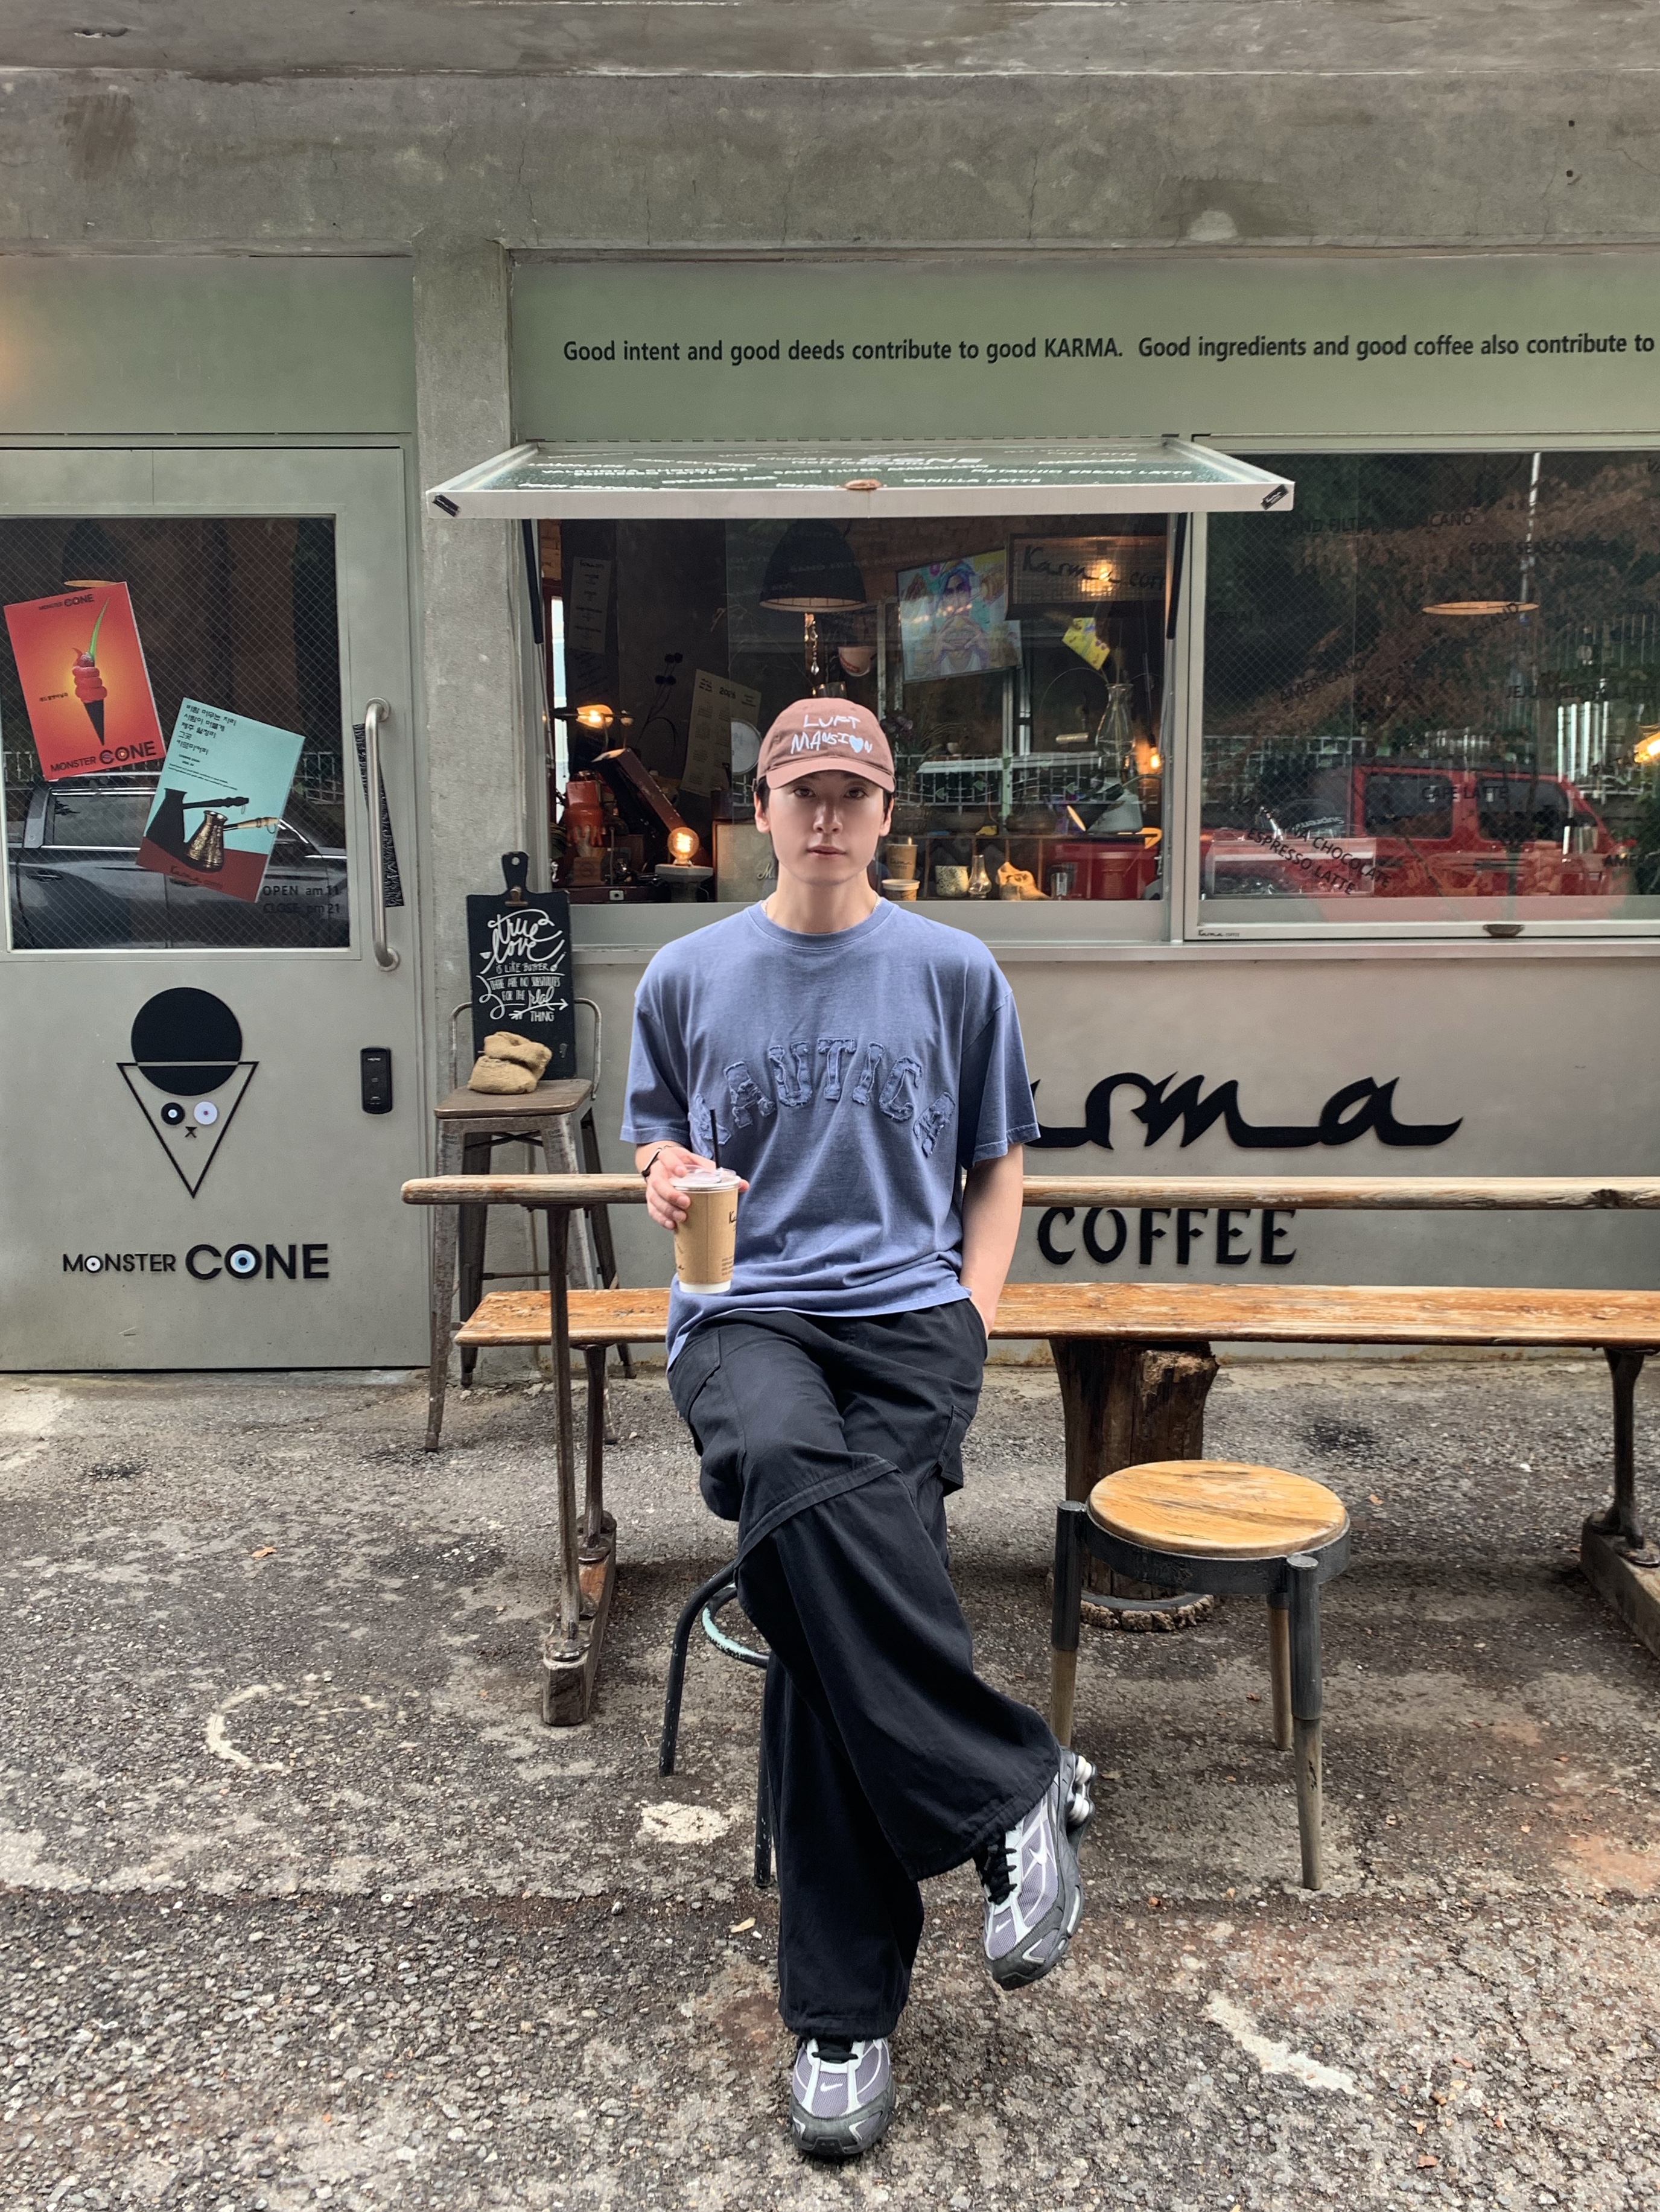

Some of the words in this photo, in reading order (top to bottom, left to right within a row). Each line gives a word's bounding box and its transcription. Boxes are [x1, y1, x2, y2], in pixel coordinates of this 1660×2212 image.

[565, 341, 615, 361] Good
[625, 341, 680, 361] intent
[688, 341, 722, 361] and
[731, 340, 780, 366] good
[789, 340, 845, 360] deeds
[853, 339, 952, 360] contribute
[959, 342, 979, 359] to
[987, 338, 1036, 364] good
[1046, 338, 1123, 358] KARMA.
[1140, 337, 1191, 357] Good
[1200, 336, 1306, 363] ingredients
[1314, 336, 1349, 356] and
[1357, 335, 1407, 362] good
[1415, 335, 1474, 356] coffee
[1481, 335, 1519, 355] also
[1527, 334, 1627, 354] contribute
[1635, 335, 1655, 353] to
[64, 594, 95, 607] CONE
[803, 714, 861, 729] LUFT
[50, 756, 97, 772] MONSTER
[99, 740, 157, 764] CONE
[1248, 828, 1312, 871] ESPRESSO
[1314, 865, 1355, 895] LATTE
[1312, 836, 1392, 889] CHOCOLATE
[262, 885, 299, 896] OPEN
[530, 1011, 555, 1022] THING
[1037, 1207, 1297, 1265] COFFEE
[63, 1254, 176, 1273] MONSTER
[186, 1244, 329, 1280] CONE
